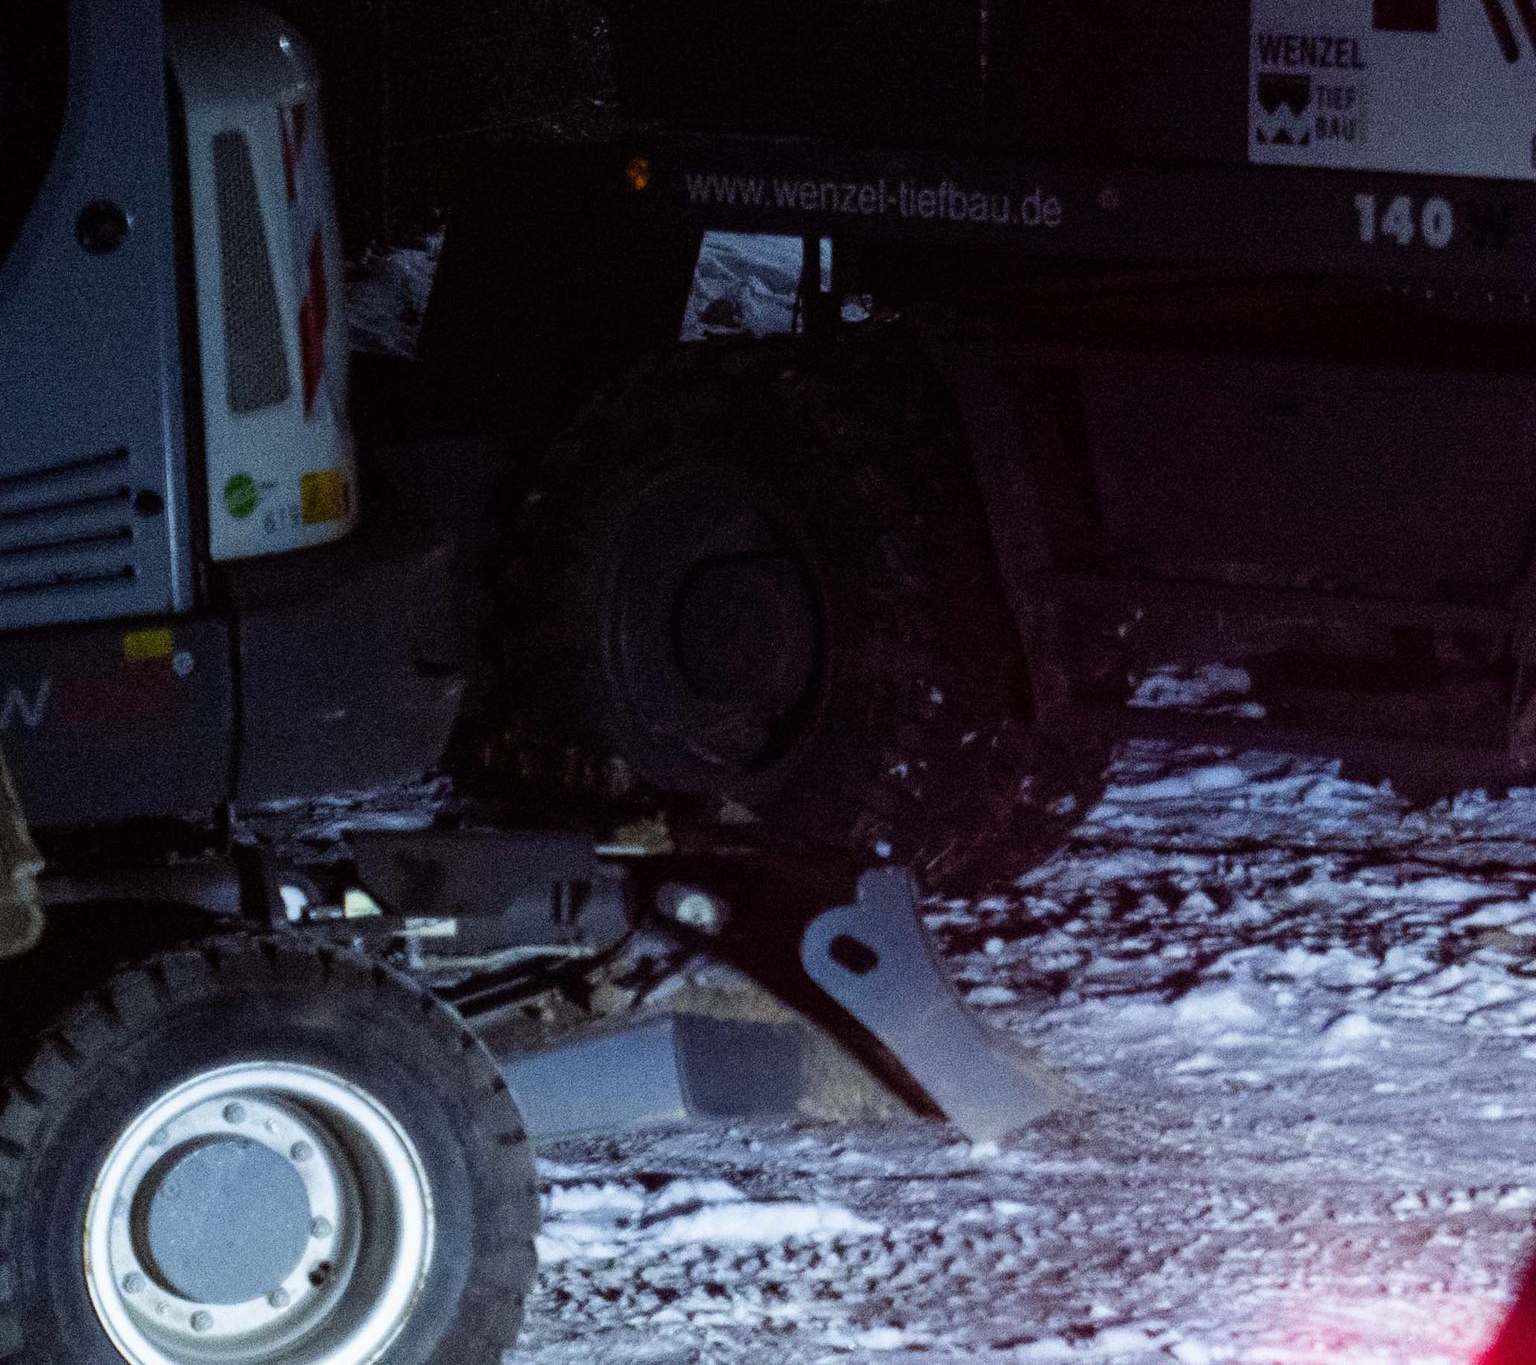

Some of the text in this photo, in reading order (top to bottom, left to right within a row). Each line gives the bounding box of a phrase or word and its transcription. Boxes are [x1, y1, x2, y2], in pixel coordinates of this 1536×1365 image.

[1258, 34, 1367, 69] WENZEL
[686, 174, 1063, 226] www.wenzel-tiefbau.de
[1353, 193, 1454, 248] 140
